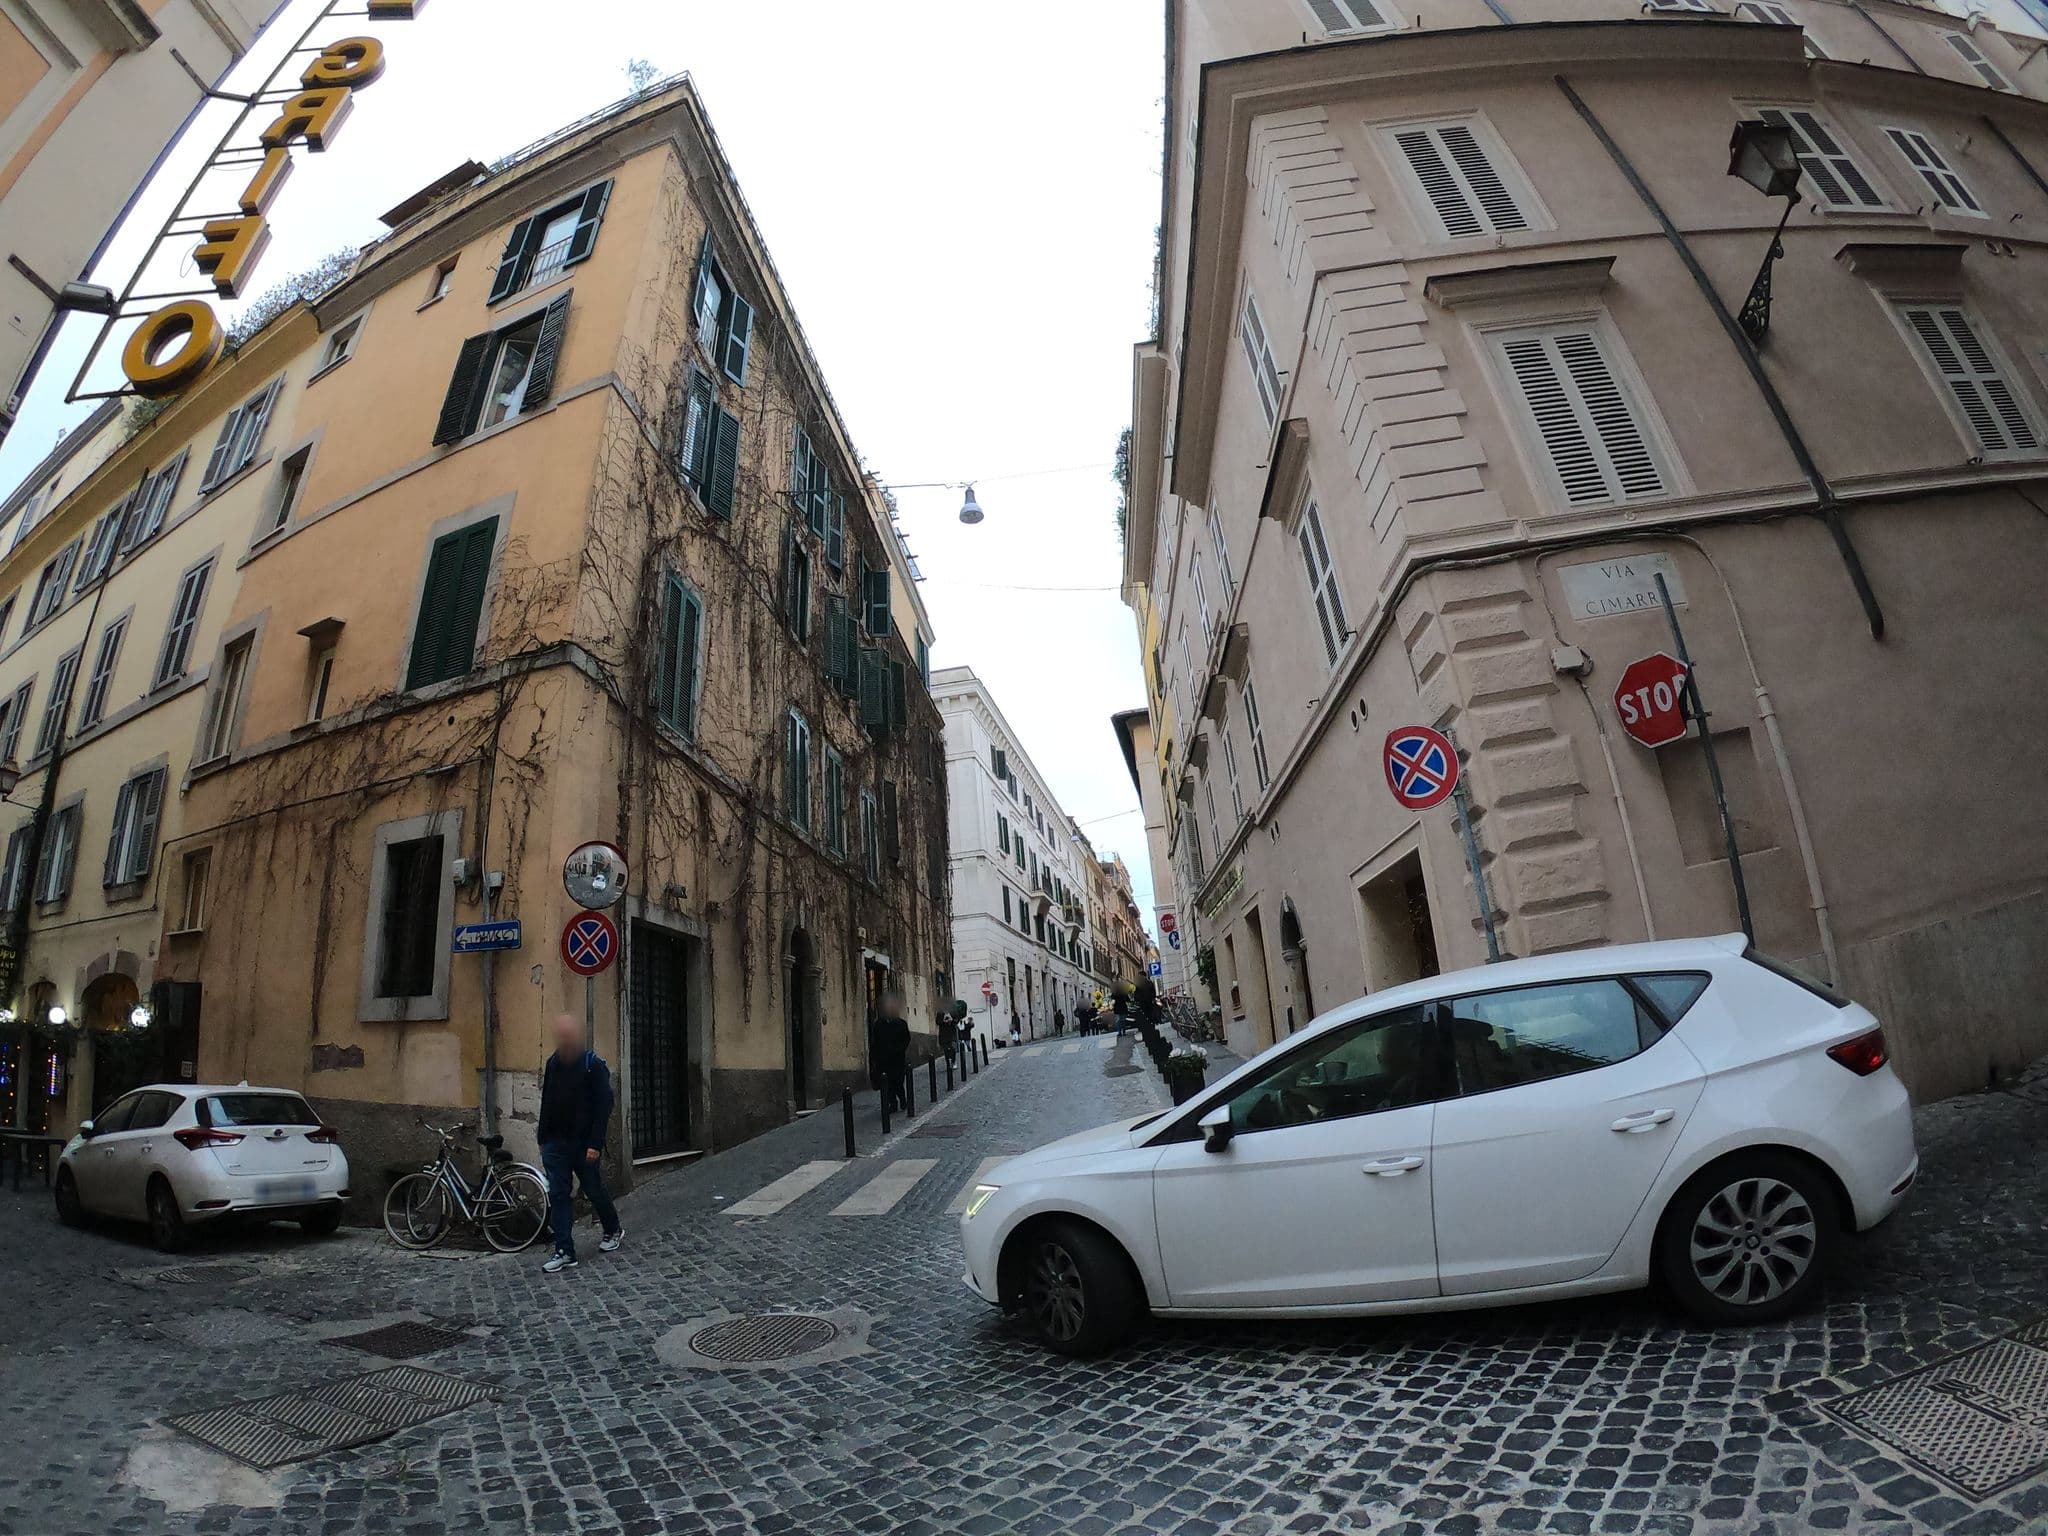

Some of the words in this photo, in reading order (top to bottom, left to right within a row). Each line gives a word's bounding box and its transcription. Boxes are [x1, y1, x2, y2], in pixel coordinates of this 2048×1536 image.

[1600, 565, 1635, 580] VIA
[1585, 591, 1660, 615] CIMARR
[1620, 673, 1686, 724] STOP
